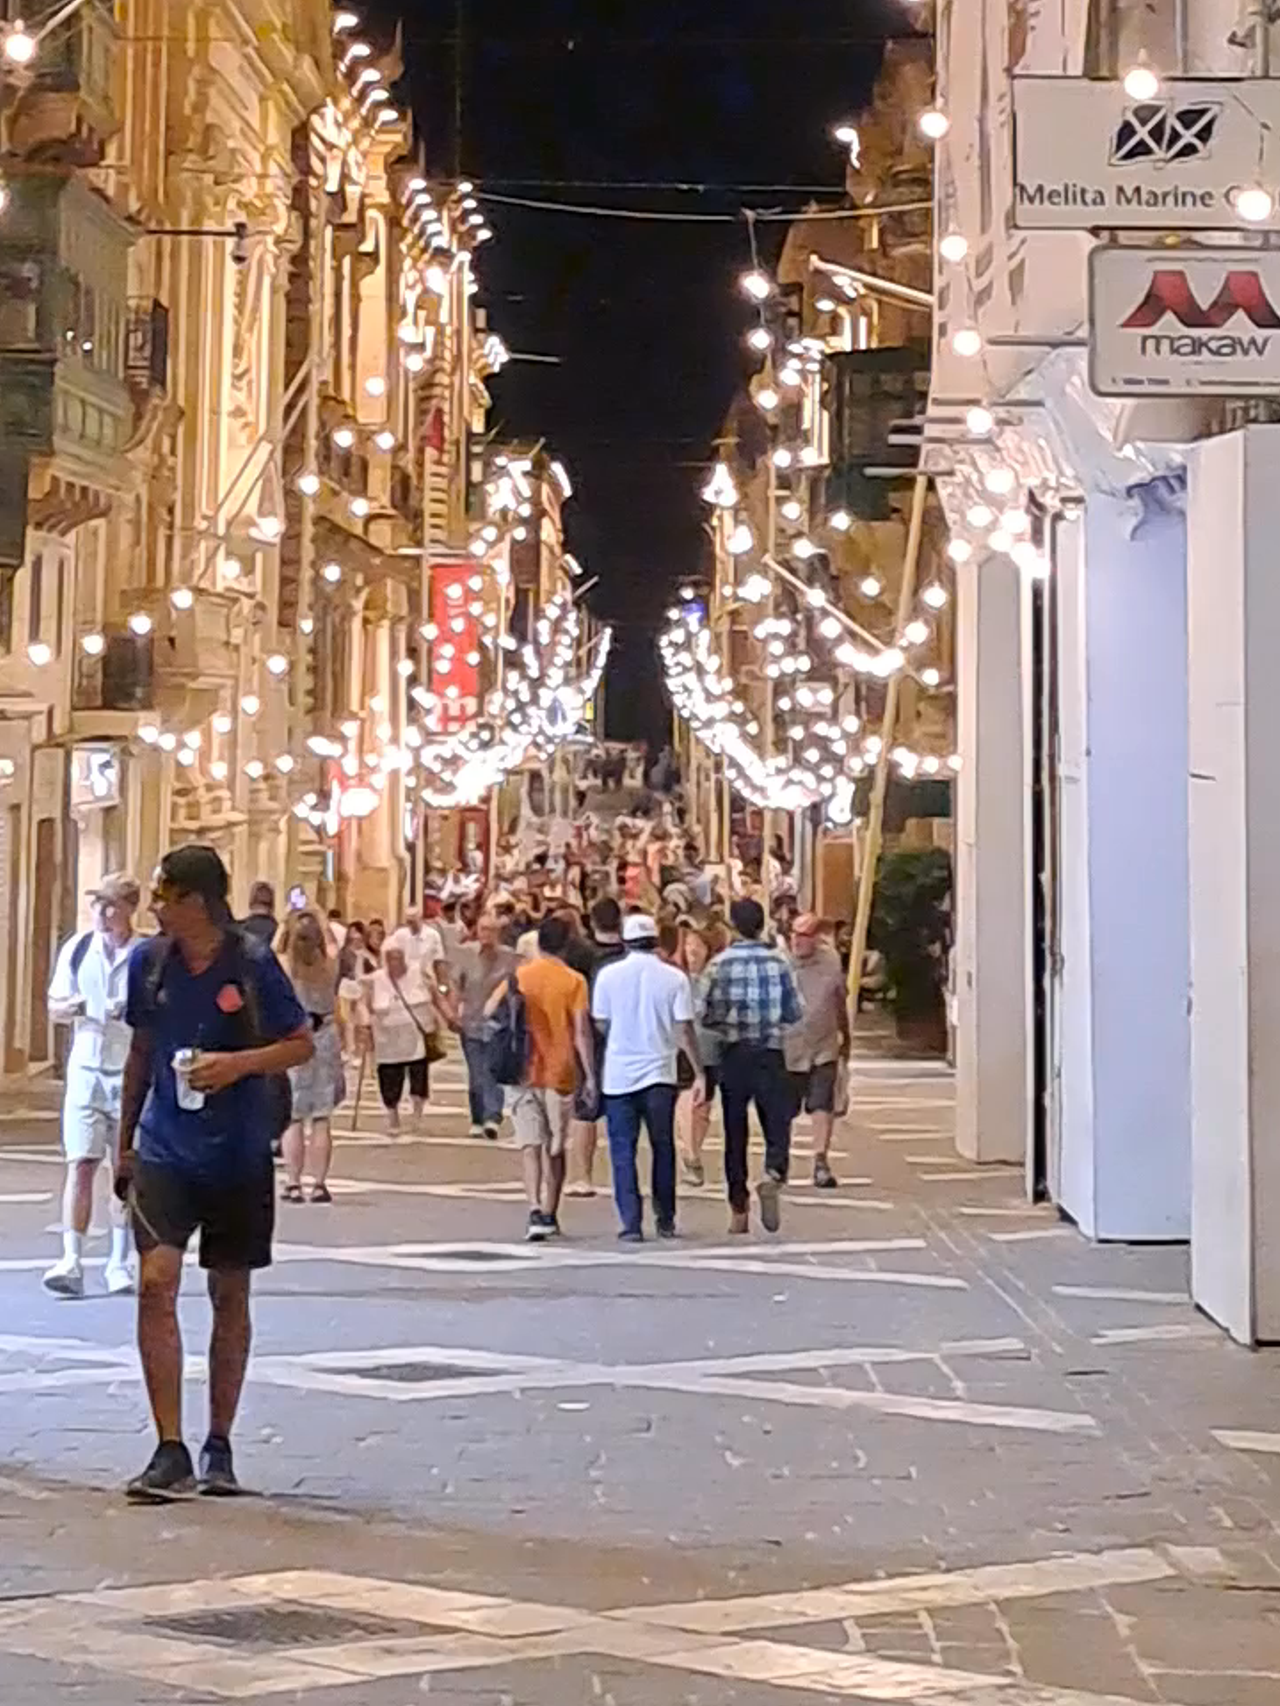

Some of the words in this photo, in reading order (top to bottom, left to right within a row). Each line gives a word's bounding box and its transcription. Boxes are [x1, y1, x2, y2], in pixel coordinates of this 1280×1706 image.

[1018, 182, 1106, 208] Melita
[1115, 183, 1214, 208] Marine
[1140, 334, 1273, 357] makaw
